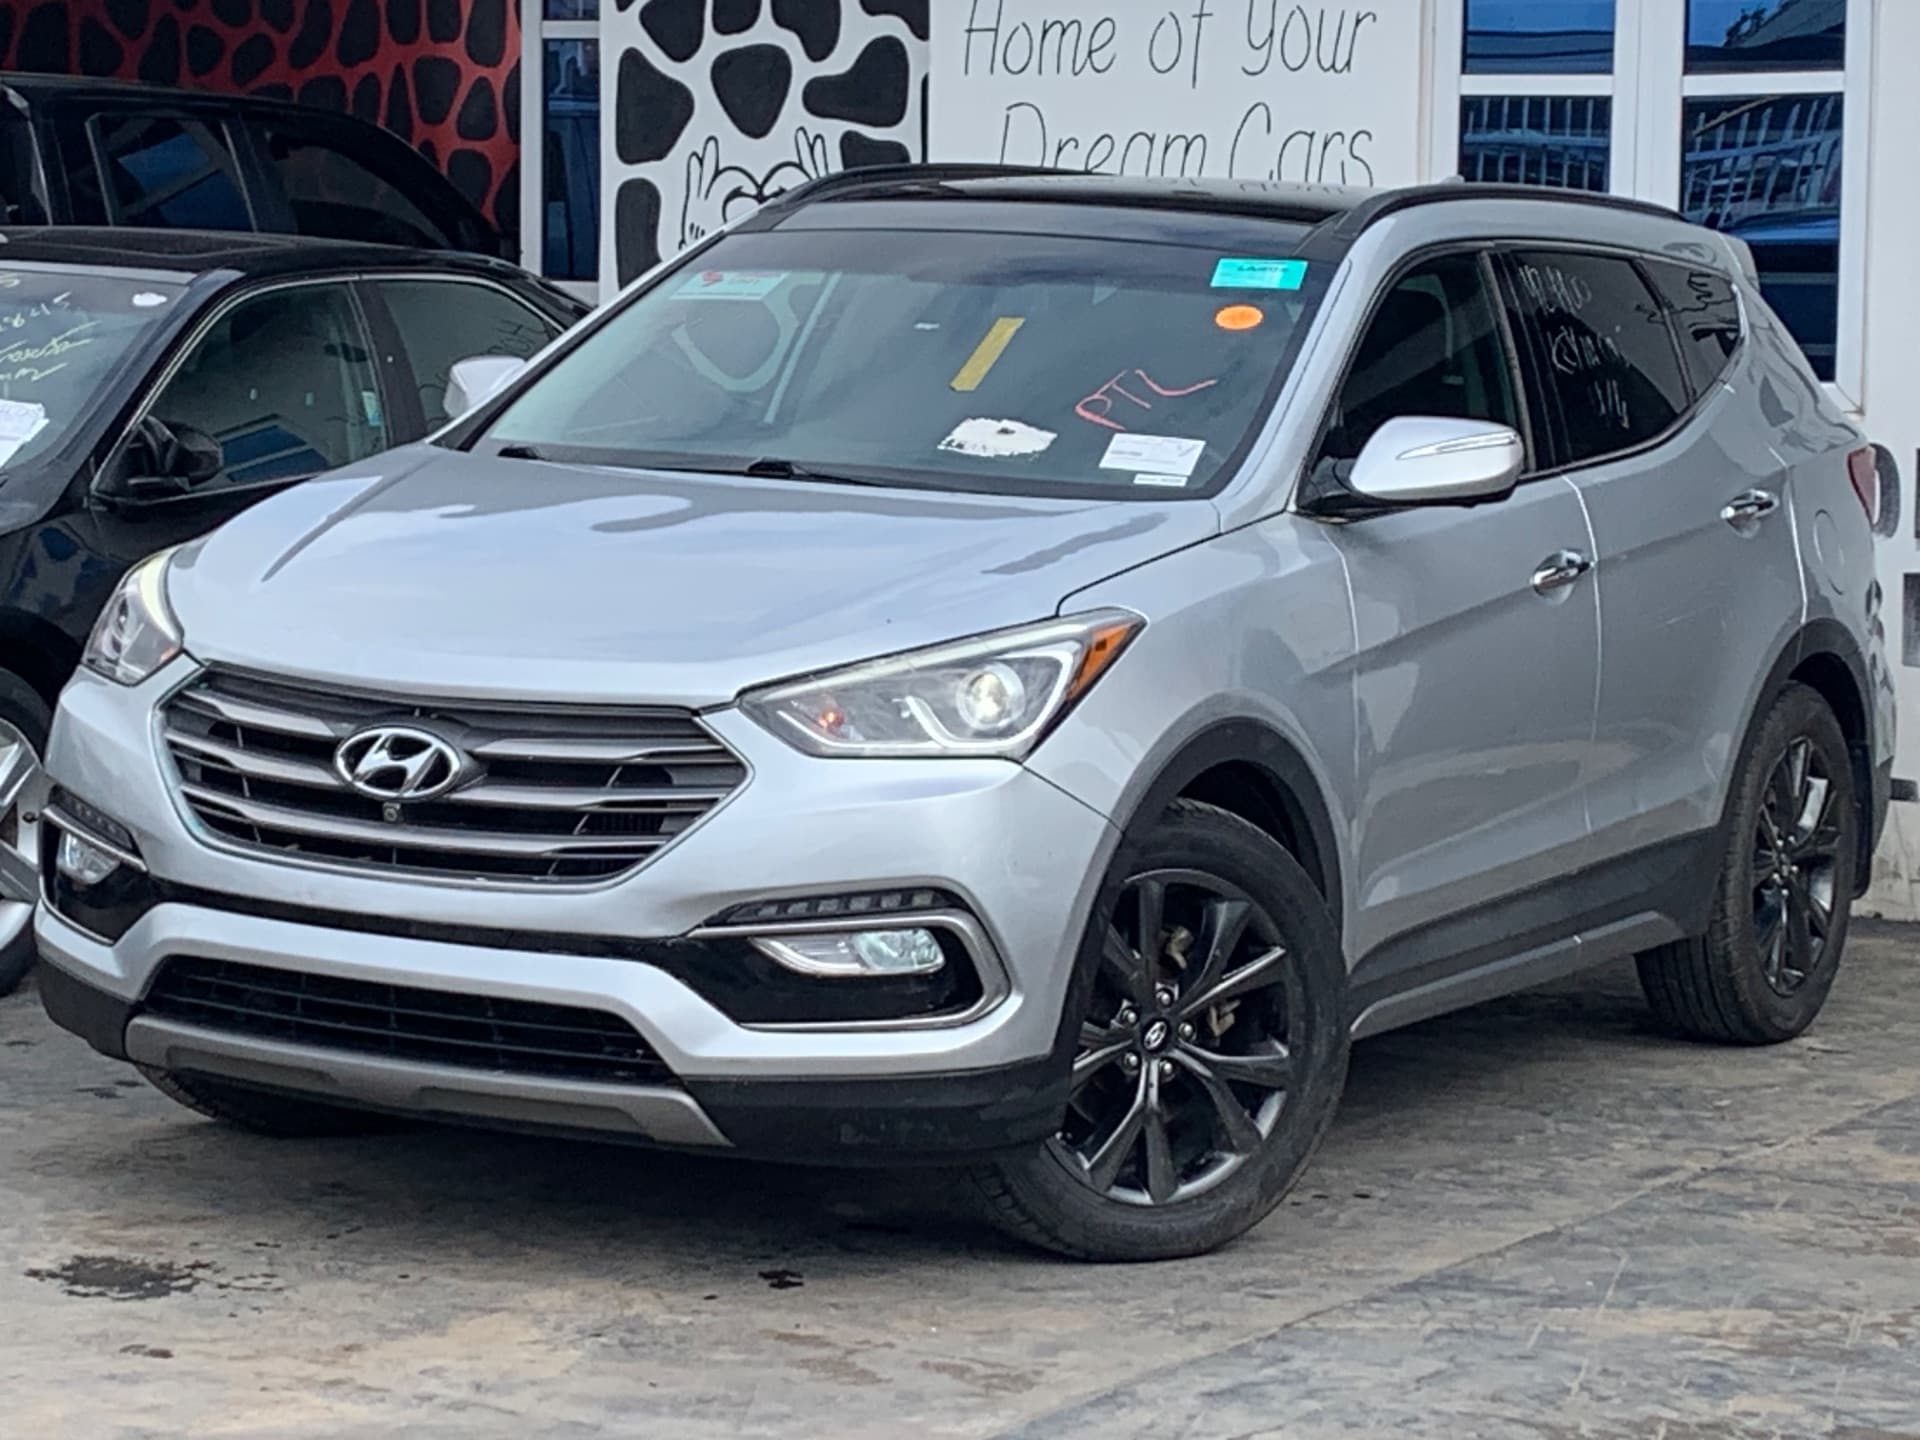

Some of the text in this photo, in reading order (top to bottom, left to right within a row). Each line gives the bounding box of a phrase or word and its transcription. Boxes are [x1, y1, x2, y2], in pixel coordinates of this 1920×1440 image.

[964, 0, 1377, 89] Home of Your
[1000, 102, 1374, 188] Dream Cars
